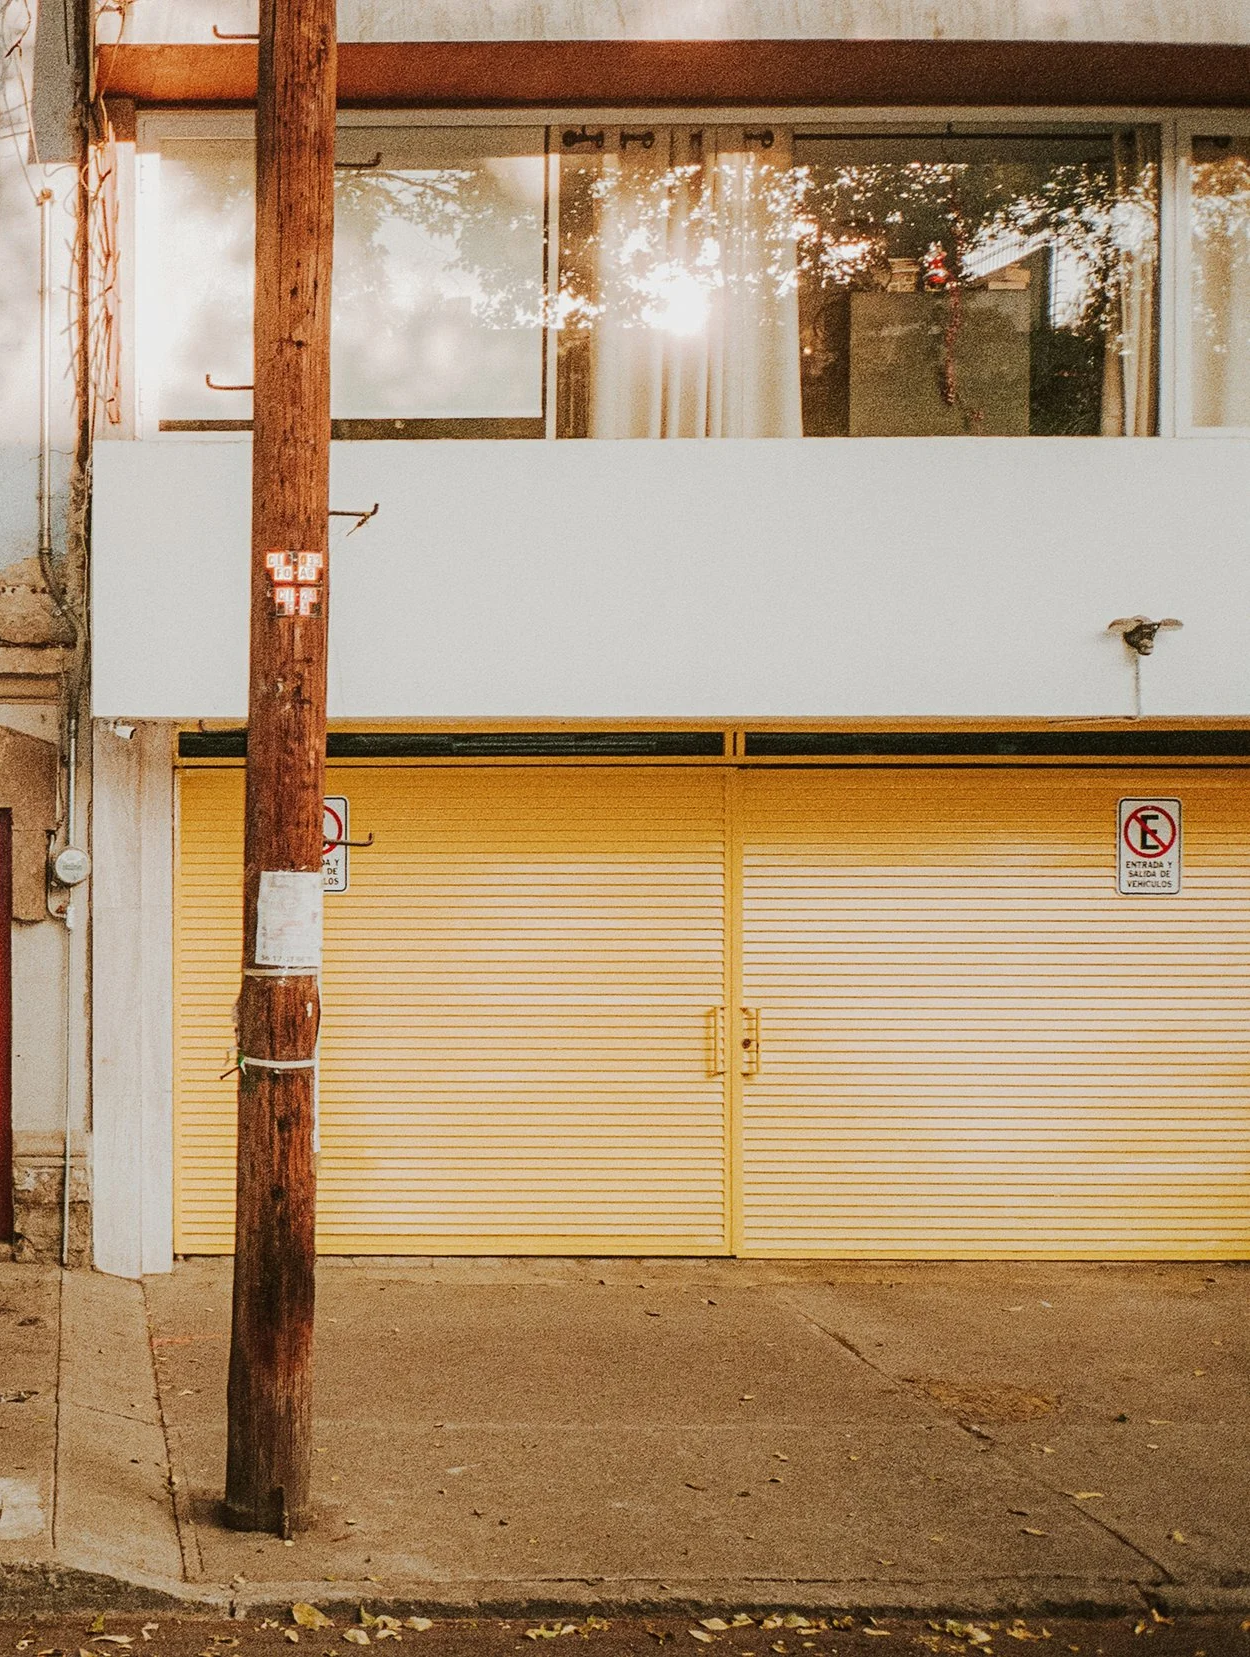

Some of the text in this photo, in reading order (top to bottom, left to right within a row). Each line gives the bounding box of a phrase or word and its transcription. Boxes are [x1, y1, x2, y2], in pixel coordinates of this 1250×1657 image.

[1140, 814, 1160, 850] E
[1125, 861, 1173, 869] ENTRADA Y
[327, 867, 338, 875] DE
[1128, 870, 1171, 878] SALIDA DE
[1126, 880, 1173, 888] VEHICULOS
